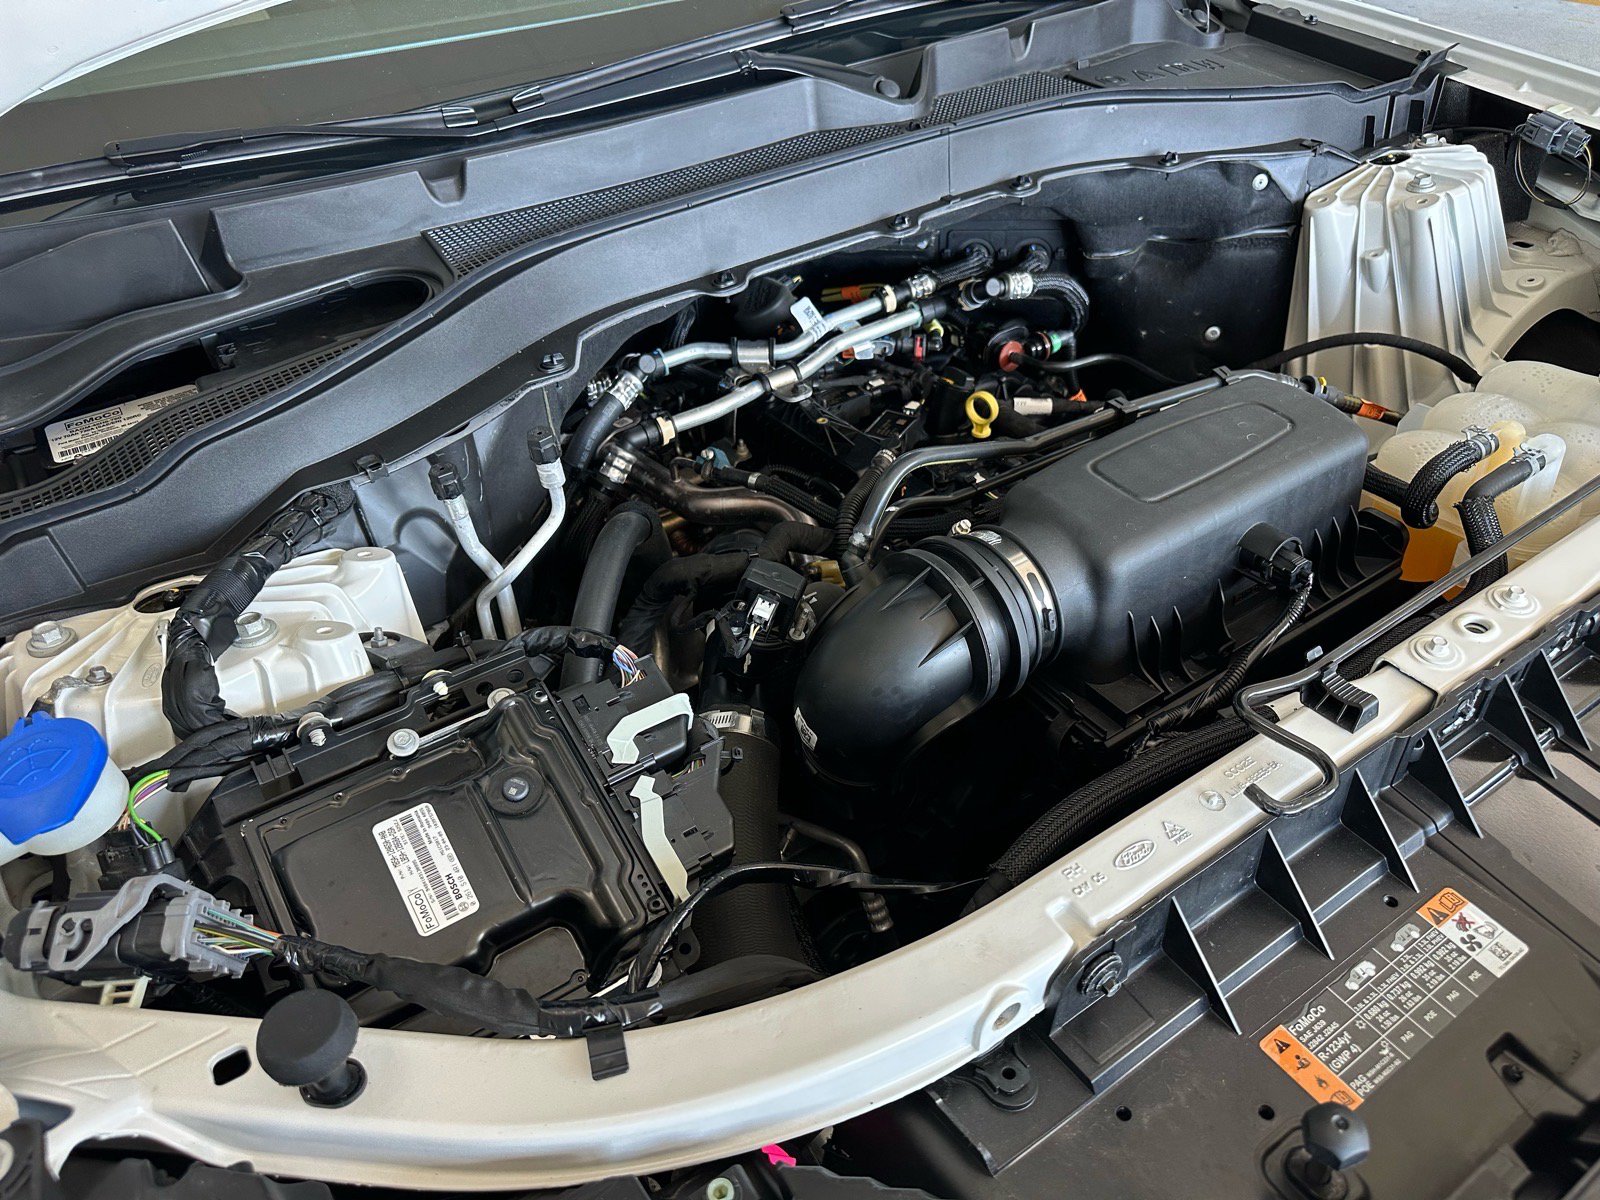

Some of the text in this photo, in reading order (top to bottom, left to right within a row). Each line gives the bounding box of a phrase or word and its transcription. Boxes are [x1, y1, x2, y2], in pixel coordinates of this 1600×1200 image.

[66, 409, 120, 428] FoMoCo
[413, 809, 424, 828] Romania
[423, 832, 432, 844] Made
[1062, 862, 1087, 881] RH
[444, 872, 462, 900] BOSCH
[463, 888, 473, 900] 261
[411, 892, 435, 929] FoMoCo
[1432, 940, 1456, 960] 0.992 kg
[1449, 950, 1458, 958] oz
[1456, 953, 1467, 962] lbs
[1410, 958, 1435, 979] 0.992 kg
[1435, 972, 1445, 981] lbs
[1468, 969, 1481, 981] POE
[1385, 971, 1400, 984] FHEV
[1386, 978, 1412, 1000] 0.737 kg
[1404, 990, 1413, 998] oz
[1411, 992, 1422, 1002] lbs
[1445, 989, 1460, 1001] PAG
[1363, 998, 1389, 1020] 0.680 kg
[1389, 1012, 1399, 1022] lbs
[1423, 1009, 1437, 1021] POE
[1287, 1002, 1326, 1036] FoMoCo
[1375, 1014, 1385, 1022] 24
[1299, 1018, 1327, 1043] SAE J639
[1306, 1020, 1340, 1050] J2842 J2845
[1399, 1029, 1414, 1043] PAG
[1317, 1030, 1354, 1063] R-1234yf
[1328, 1042, 1362, 1072] (GWP 4)
[1349, 1073, 1367, 1090] PAG
[1356, 1079, 1375, 1096] POE
